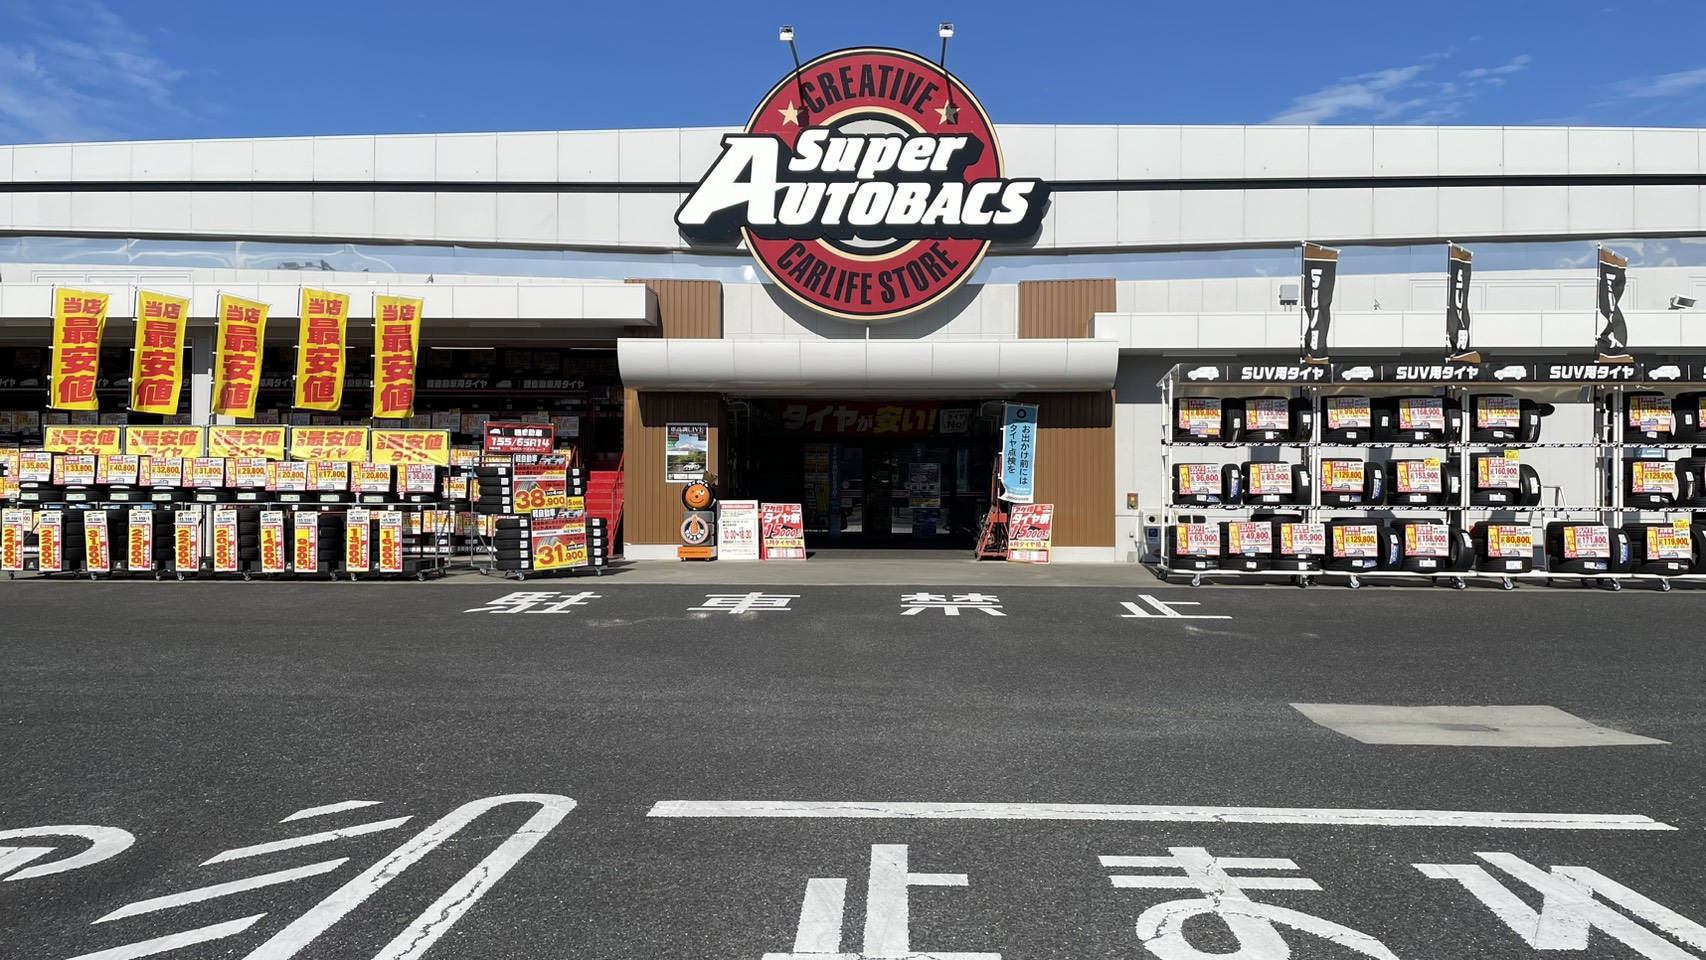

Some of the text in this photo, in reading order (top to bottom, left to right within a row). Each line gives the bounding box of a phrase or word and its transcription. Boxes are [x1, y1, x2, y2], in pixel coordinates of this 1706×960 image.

[800, 64, 939, 114] CREATIVE
[677, 137, 1036, 226] AUTOBACS
[788, 128, 968, 179] Super
[777, 241, 959, 305] CARLIFE STORE
[58, 317, 99, 403] 最安値
[137, 321, 177, 405] 最安値
[219, 324, 258, 409] 最安値
[302, 317, 340, 403] 最安値
[381, 324, 413, 411] 最安値
[1241, 366, 1324, 380] SUV用タイヤ
[1395, 366, 1479, 380] SUV用タイヤ
[1549, 365, 1634, 380] SUV用タイヤ
[491, 437, 550, 447] 155/65R14
[1007, 424, 1018, 474] タイヤ点検を
[1019, 425, 1031, 485] お出かけ前には
